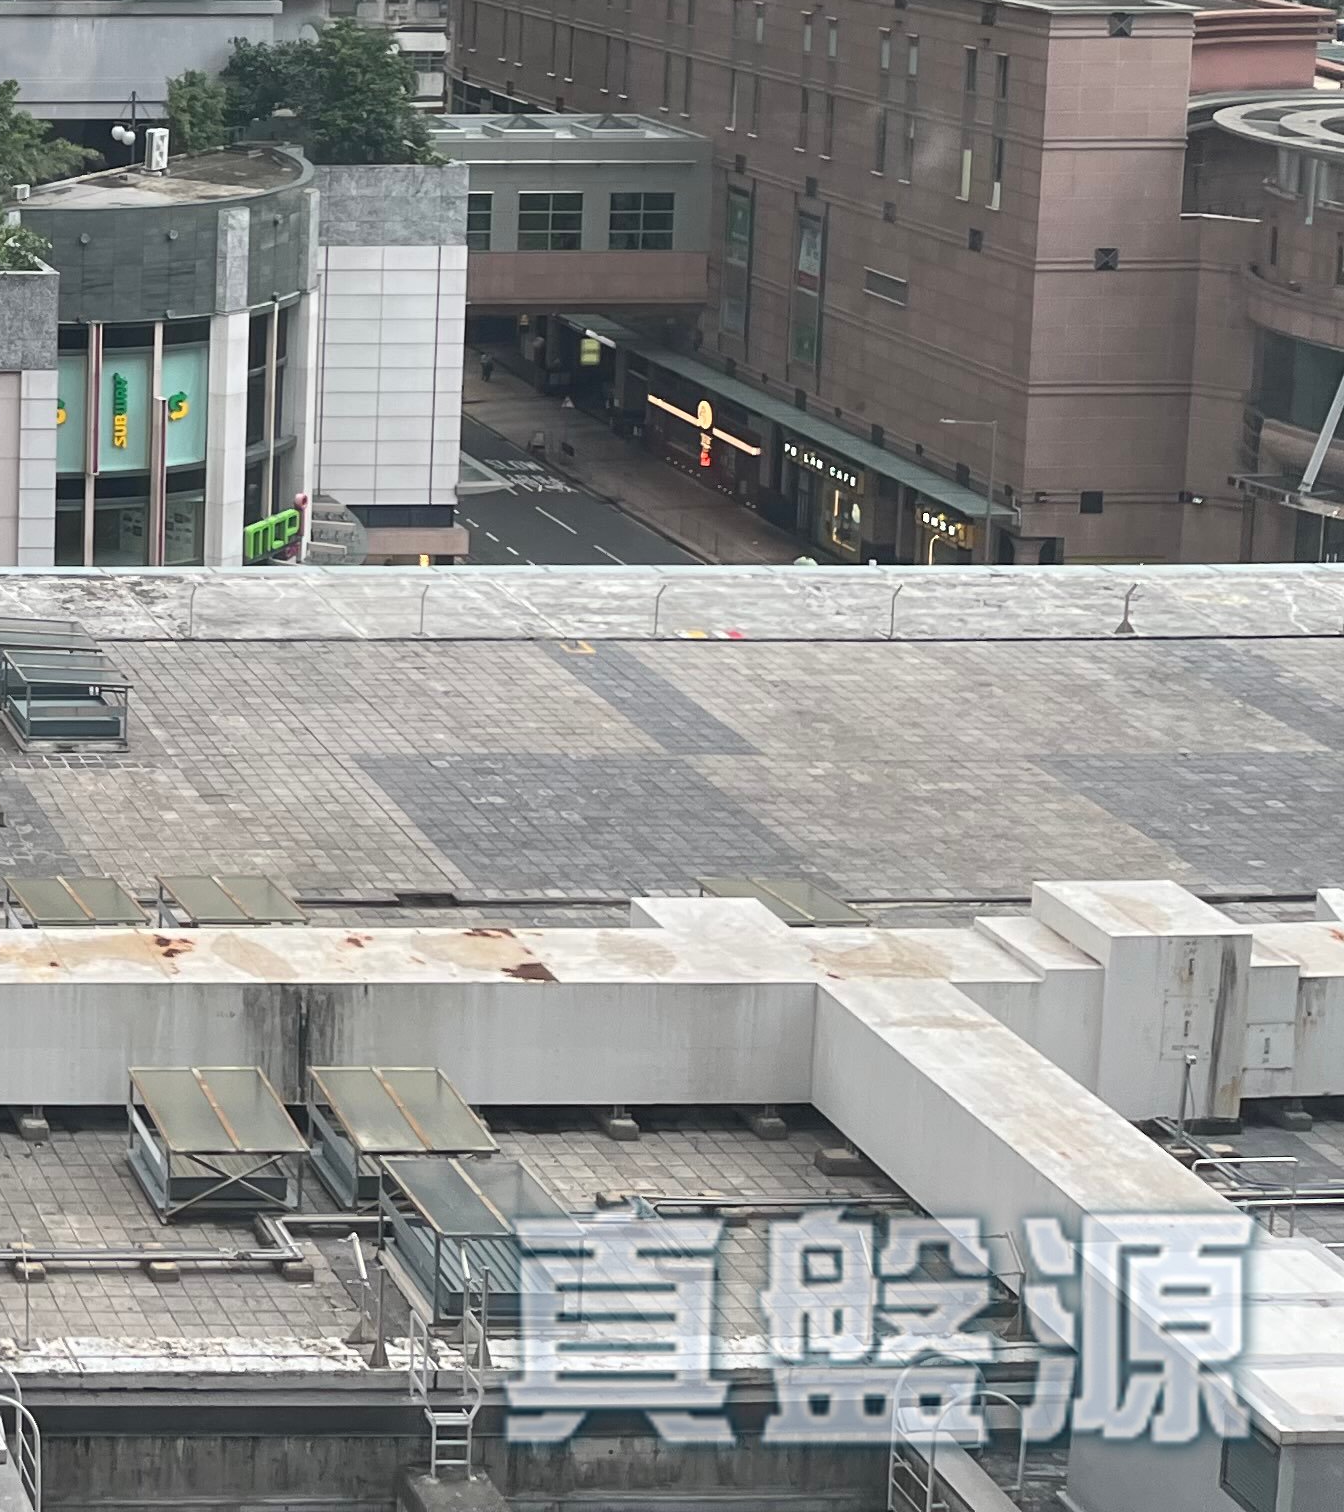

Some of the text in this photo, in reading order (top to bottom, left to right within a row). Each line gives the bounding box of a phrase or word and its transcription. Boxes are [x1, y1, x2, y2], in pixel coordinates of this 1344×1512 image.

[113, 372, 129, 449] SUBWAY
[483, 458, 545, 472] SLOW
[829, 466, 857, 488] CAFE
